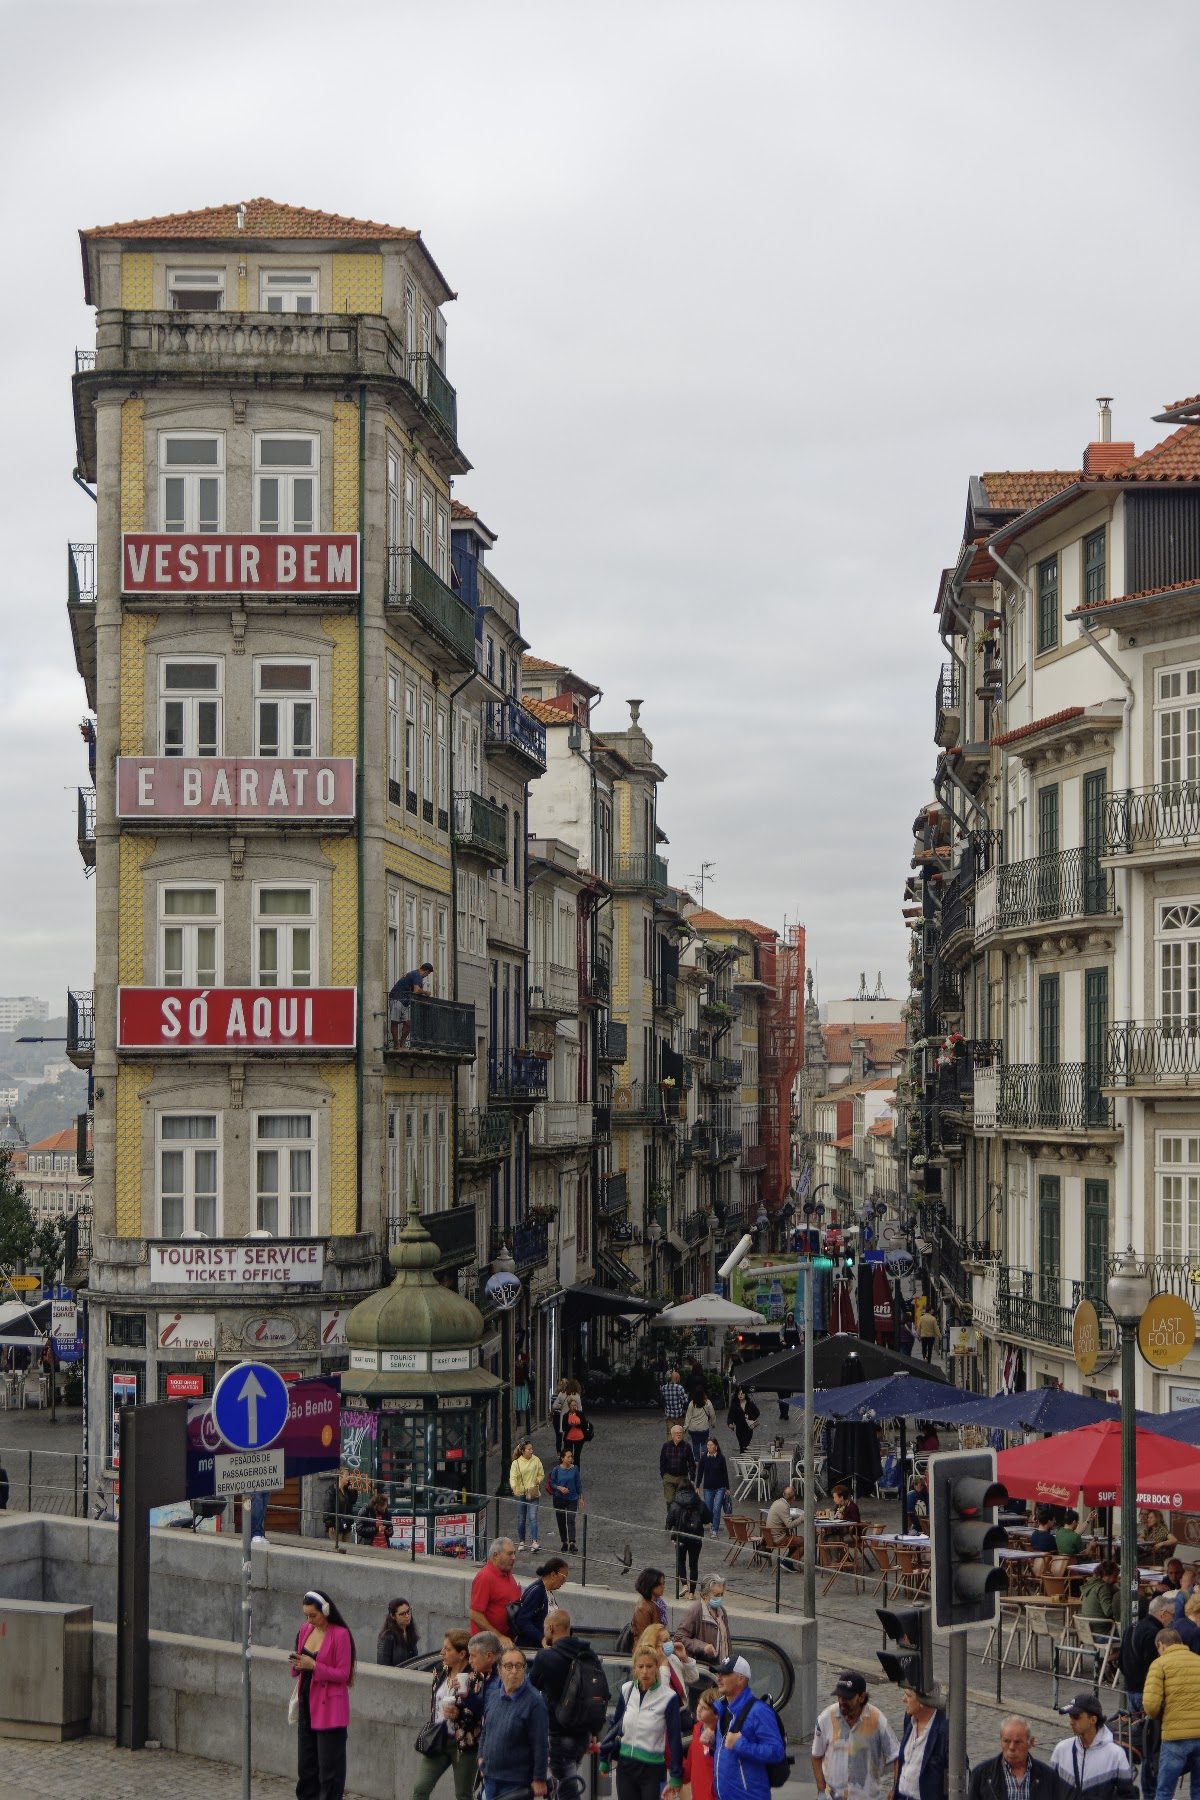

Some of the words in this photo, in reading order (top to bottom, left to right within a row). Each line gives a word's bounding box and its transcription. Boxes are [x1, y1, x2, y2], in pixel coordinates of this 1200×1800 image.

[128, 544, 260, 583] VESTIR
[278, 544, 352, 583] BEM
[139, 767, 154, 806] E
[183, 768, 335, 806] BARATO
[161, 990, 210, 1037] SÓ
[226, 997, 313, 1038] AQUI
[157, 1248, 237, 1265] TOURIST
[244, 1247, 317, 1265] SERVICE
[186, 1269, 237, 1282] TICKET
[242, 1268, 291, 1281] OFFICE
[1153, 1318, 1182, 1332] LAST
[185, 1338, 213, 1348] travel
[1148, 1331, 1186, 1347] FOLIO
[305, 1397, 333, 1416] Bento
[230, 1454, 261, 1466] PESADOS
[261, 1453, 271, 1462] DE
[222, 1466, 268, 1480] PASSAGEIROS
[217, 1481, 246, 1493] SERVIÇO
[1152, 1494, 1171, 1505] BOCK
